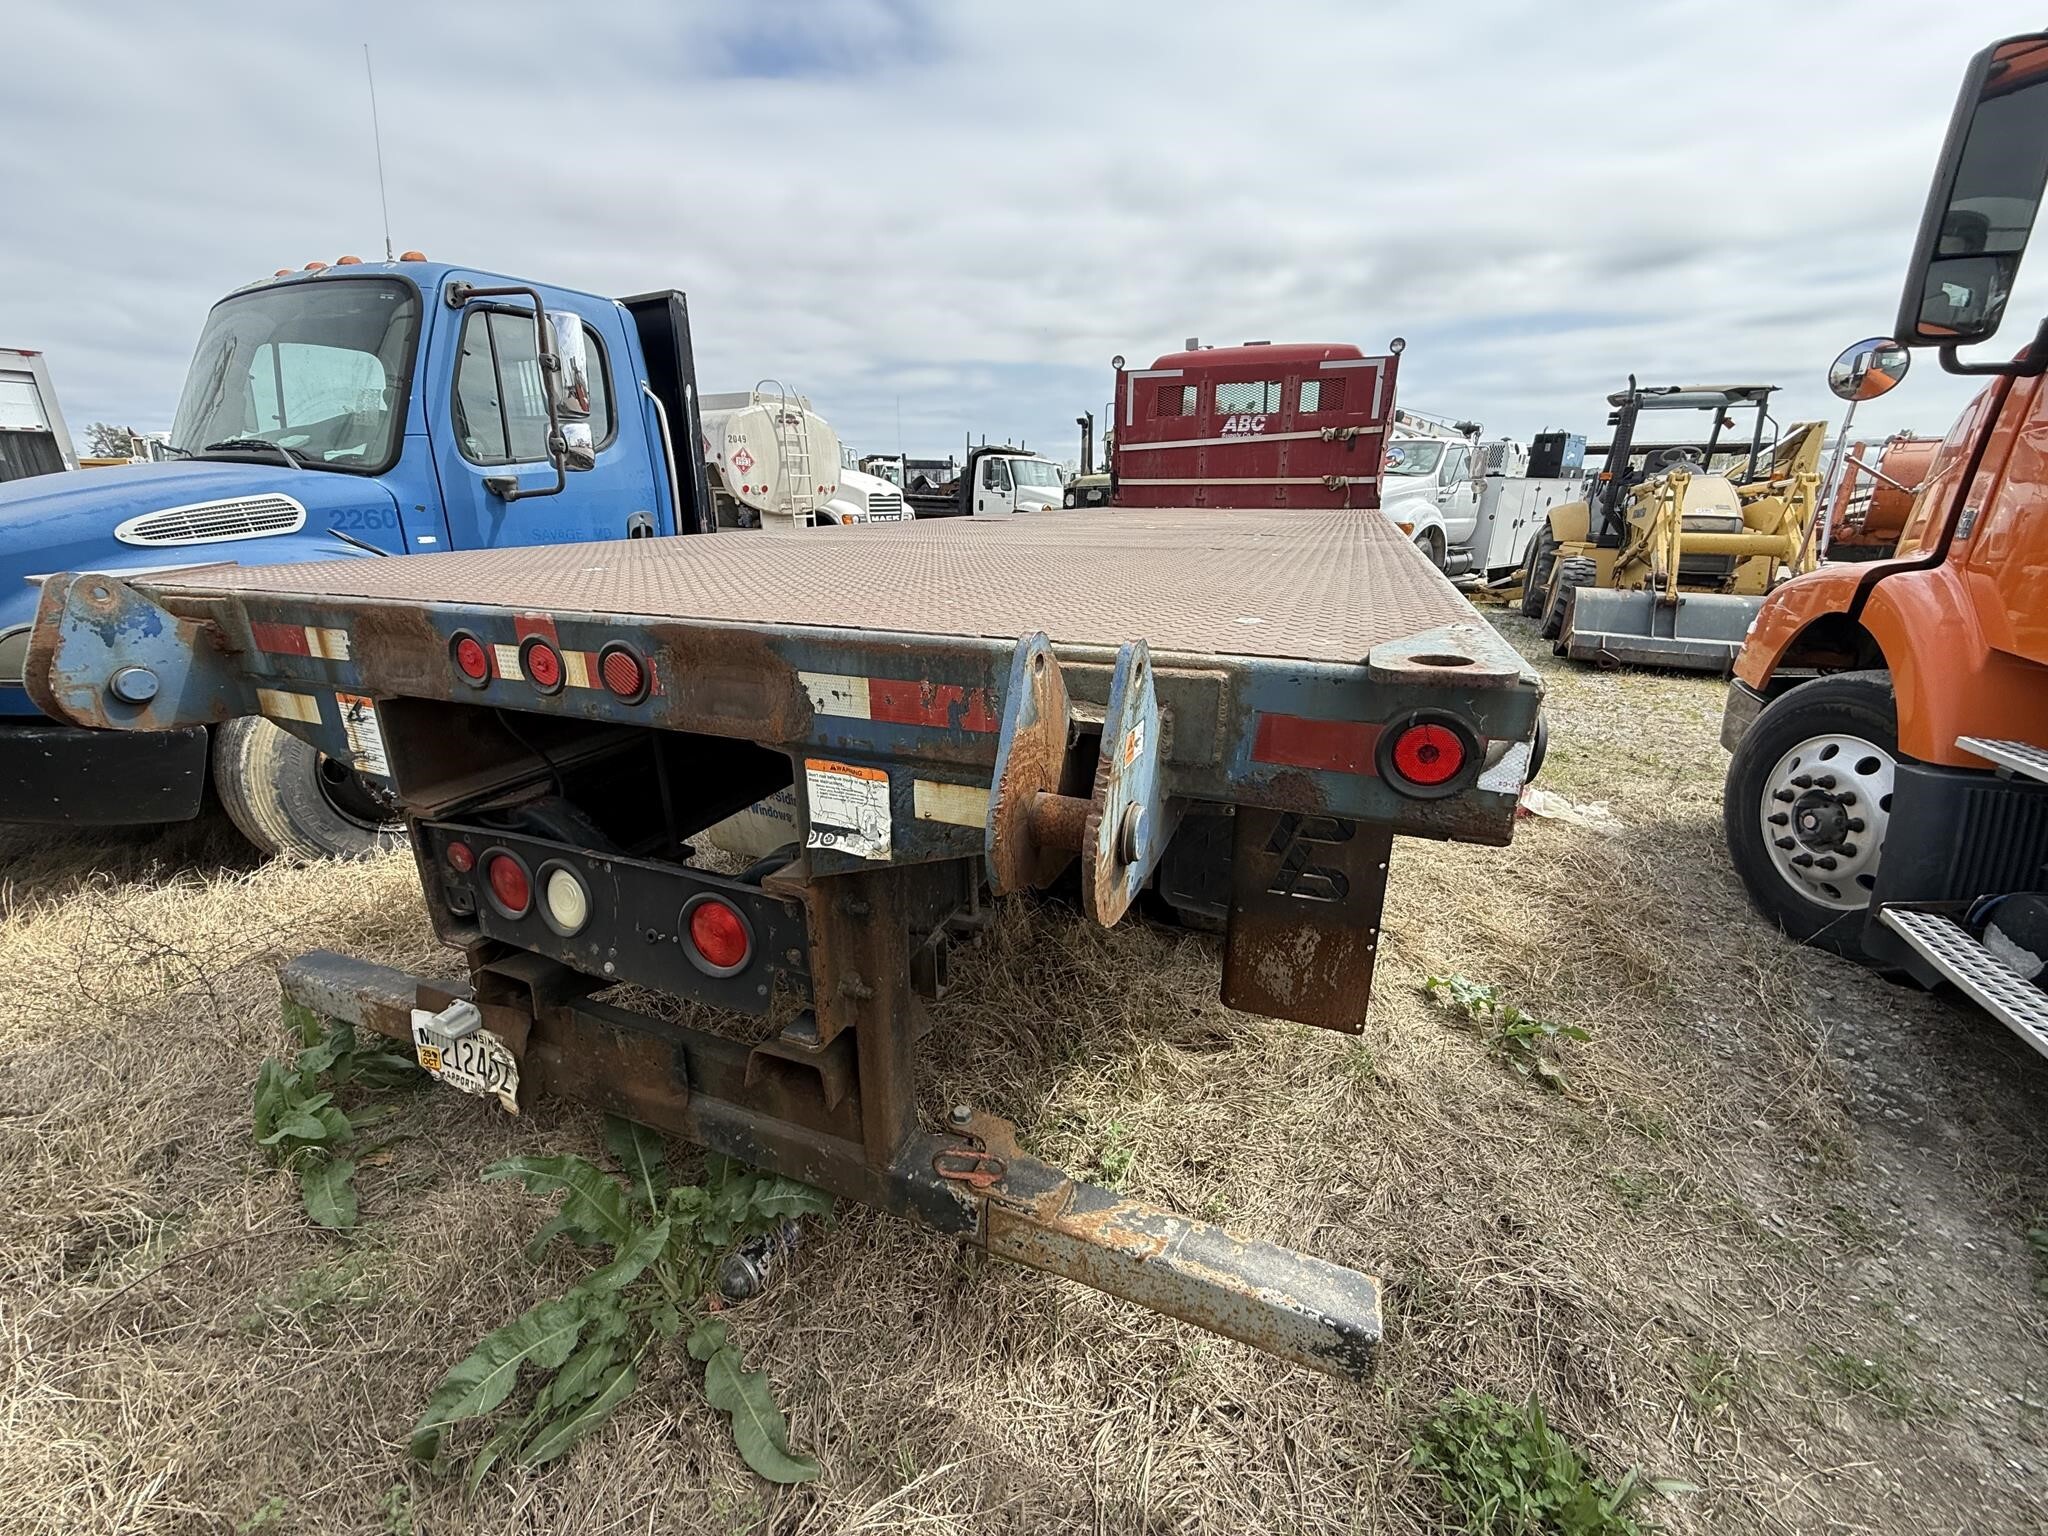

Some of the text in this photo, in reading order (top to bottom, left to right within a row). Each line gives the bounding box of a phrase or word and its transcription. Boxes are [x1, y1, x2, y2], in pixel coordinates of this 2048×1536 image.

[1219, 415, 1268, 432] ABC
[728, 434, 747, 443] 2049
[328, 508, 396, 530] 2260
[751, 802, 792, 822] Windows
[423, 1058, 437, 1067] OCT
